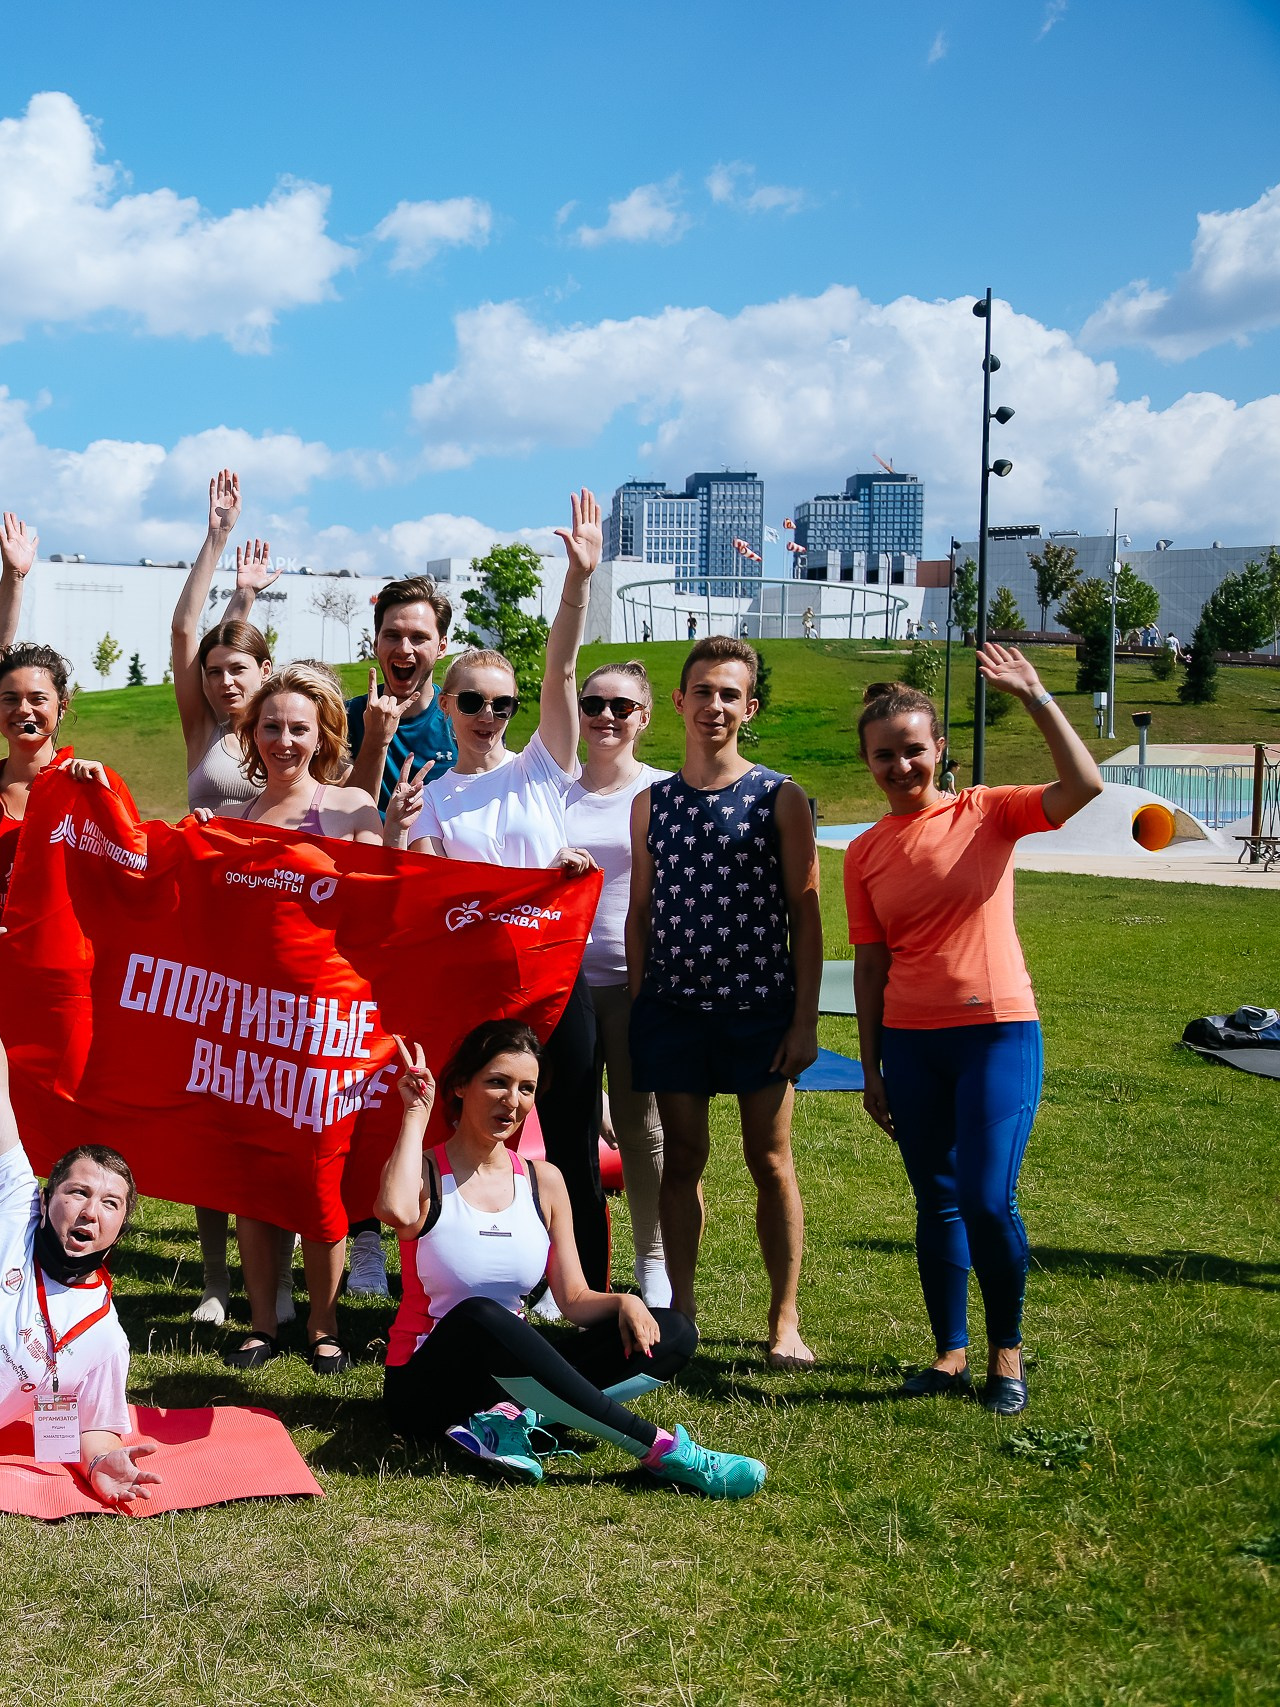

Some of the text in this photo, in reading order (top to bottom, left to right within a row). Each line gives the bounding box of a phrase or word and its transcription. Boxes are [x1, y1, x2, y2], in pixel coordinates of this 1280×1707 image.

[488, 912, 540, 930] ОСКВА
[120, 953, 378, 1059] СПОРТИВНЫЕ
[186, 1037, 398, 1133] ВЫХОДНЫЕ
